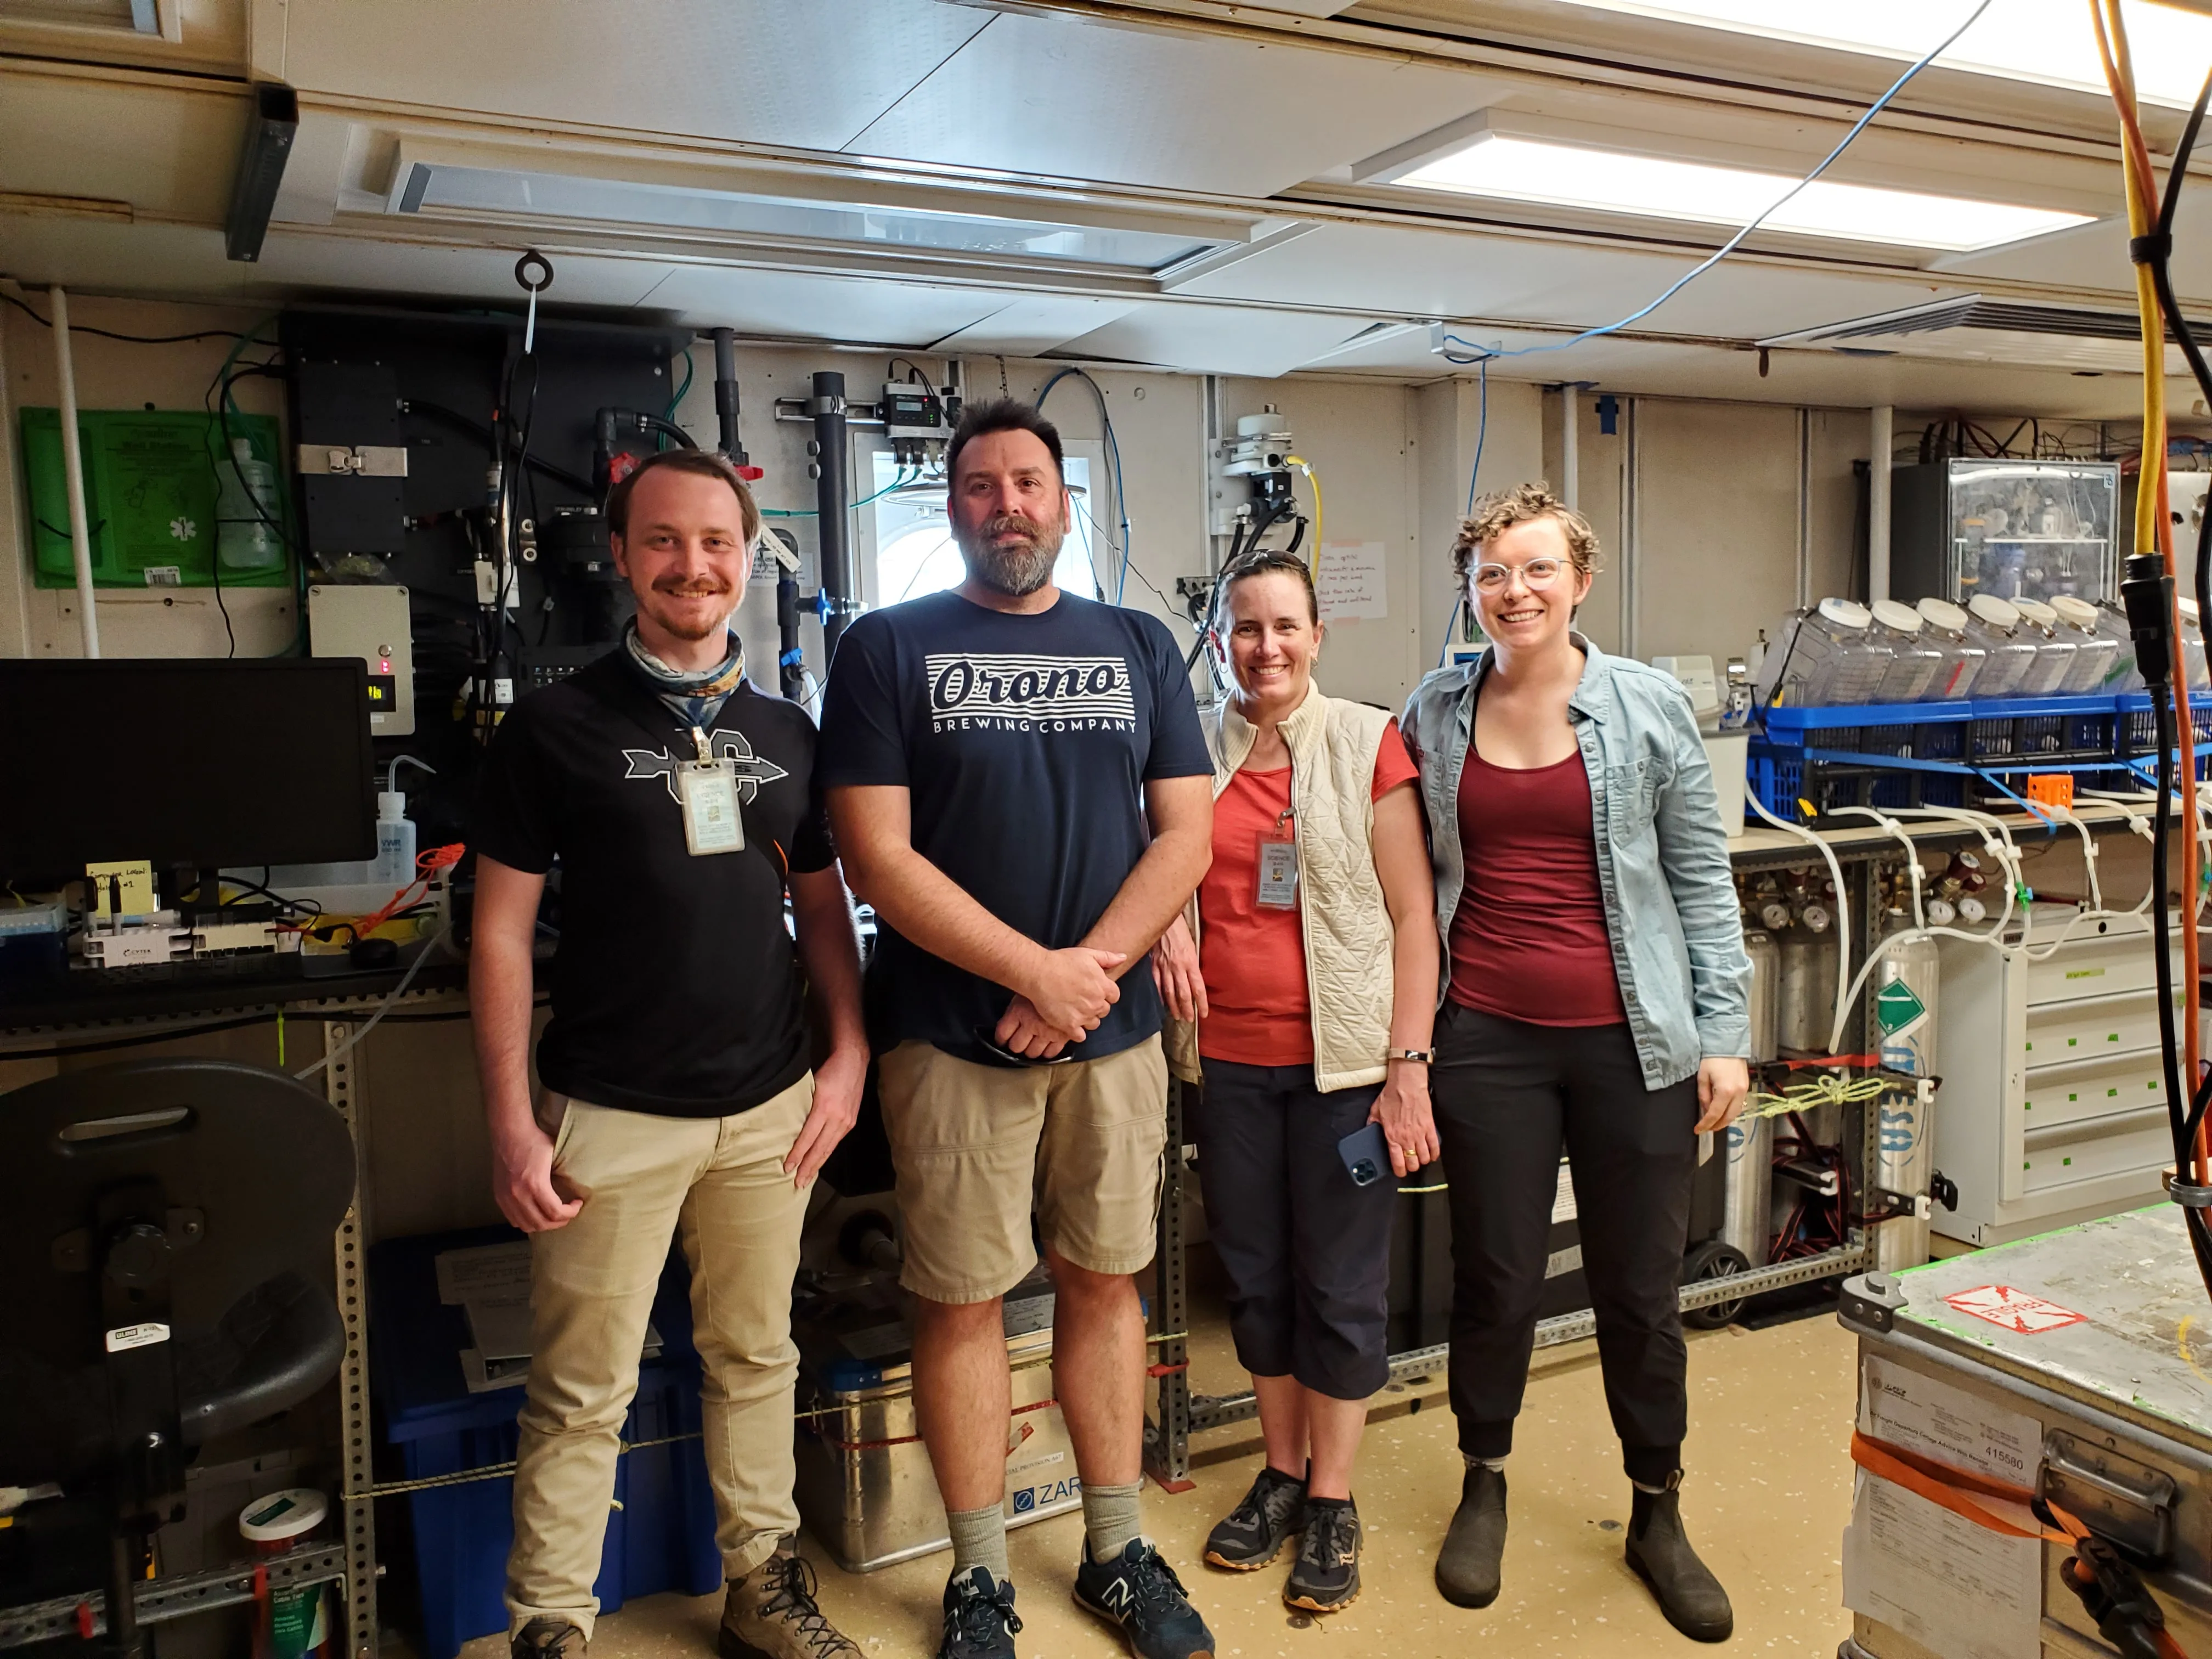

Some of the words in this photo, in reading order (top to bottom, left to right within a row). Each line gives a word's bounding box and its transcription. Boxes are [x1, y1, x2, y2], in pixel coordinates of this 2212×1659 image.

[933, 660, 1129, 710] Orono
[934, 718, 1030, 733] BREWING
[1039, 719, 1136, 733] COMPANY
[1980, 1299, 2044, 1318] FRAGILE
[116, 1329, 137, 1339] ULINE
[1894, 1420, 1918, 1435] Departure
[1019, 1458, 1050, 1471] PROVISION
[1985, 1447, 2024, 1470] 415580
